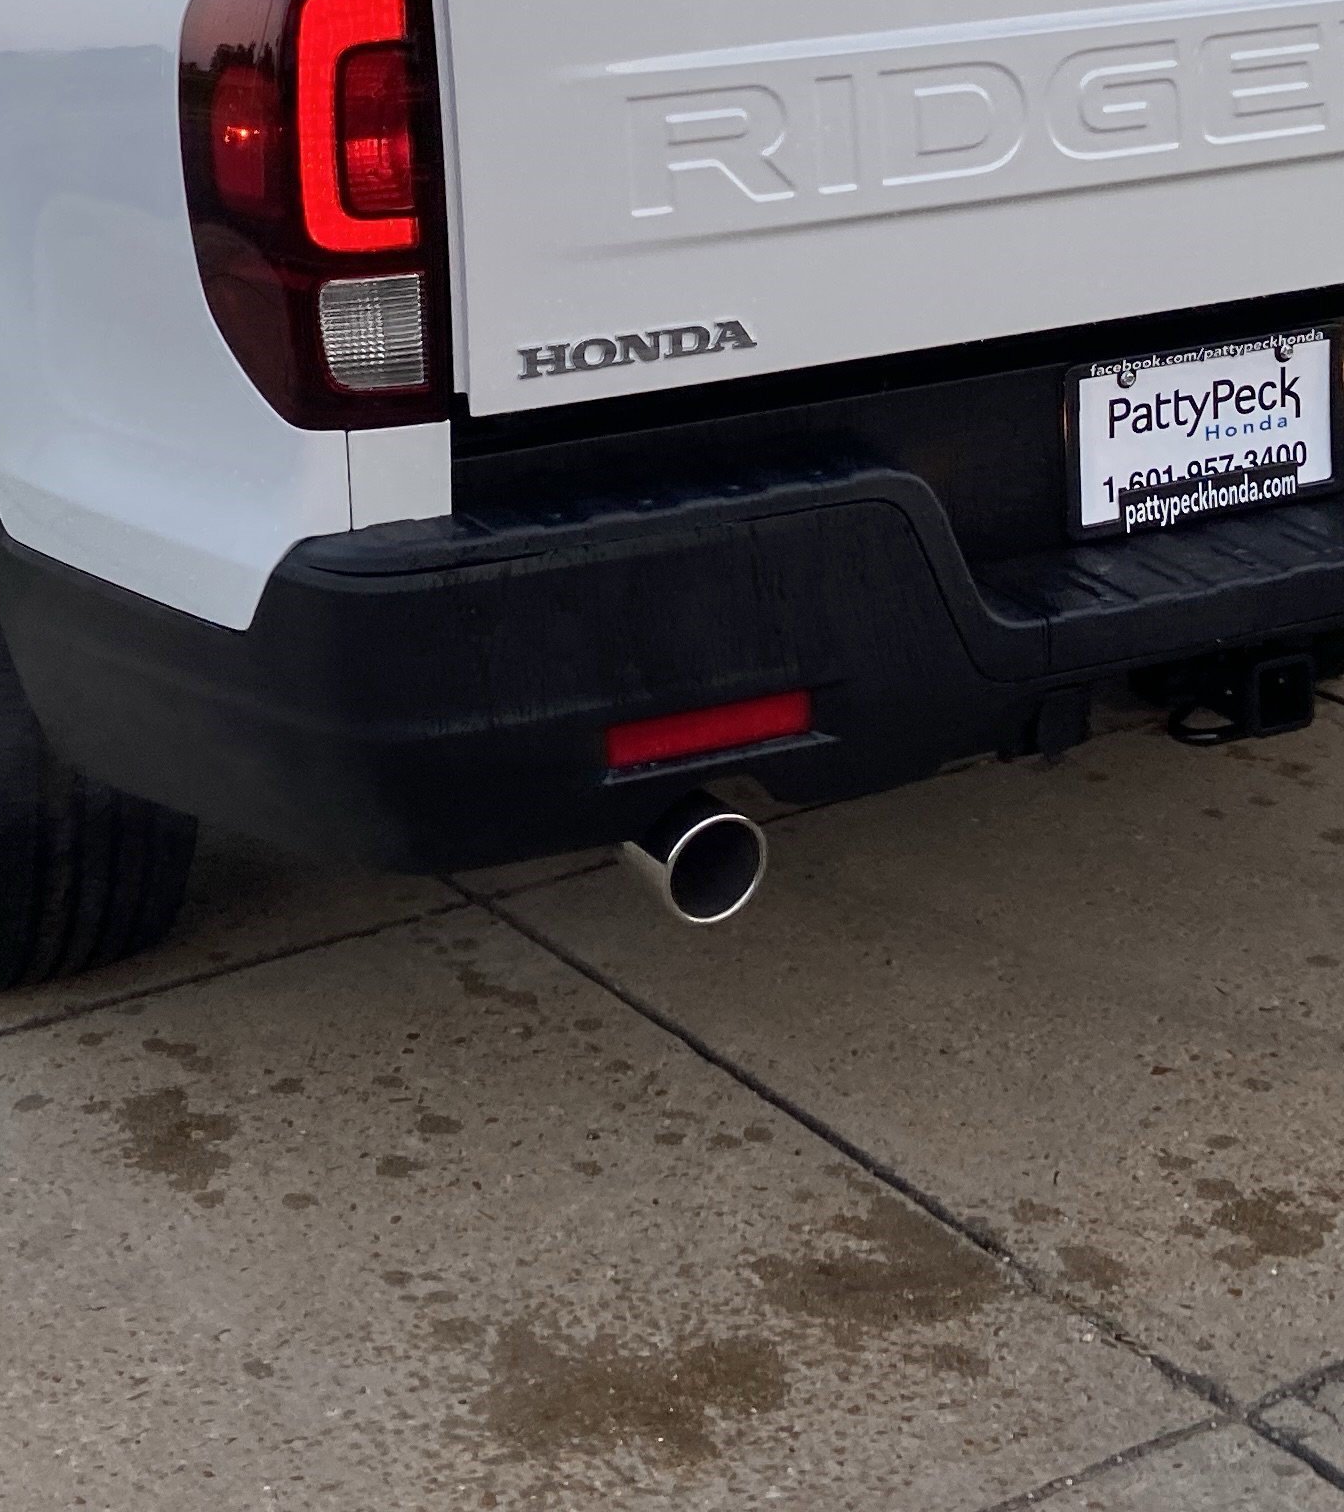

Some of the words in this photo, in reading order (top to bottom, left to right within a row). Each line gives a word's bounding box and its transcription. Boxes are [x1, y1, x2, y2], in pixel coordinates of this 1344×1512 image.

[517, 320, 758, 379] HONDA
[1090, 329, 1324, 376] facebook.com/pattypeckhonda
[1205, 415, 1288, 441] Honda
[1125, 473, 1296, 534] pattypeckhonda.com
